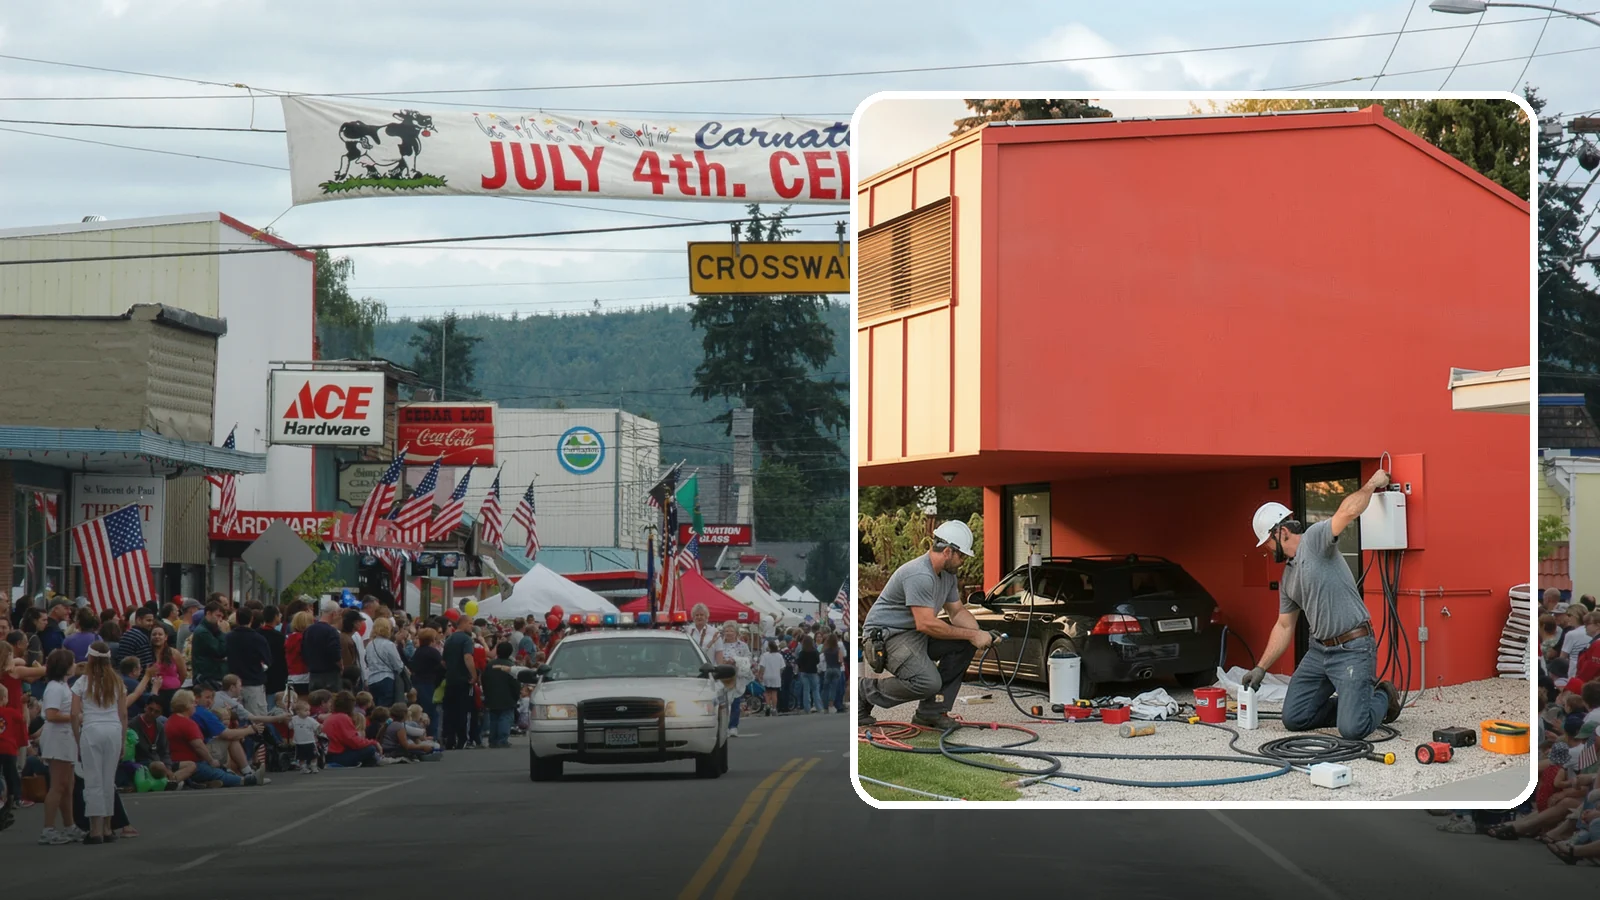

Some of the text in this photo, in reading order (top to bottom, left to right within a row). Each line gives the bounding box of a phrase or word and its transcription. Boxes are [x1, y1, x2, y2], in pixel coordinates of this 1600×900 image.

[481, 141, 605, 193] JULY
[633, 150, 746, 198] 4th.
[697, 254, 850, 280] CROSSWA
[283, 380, 373, 419] ACE
[405, 409, 452, 422] CEDAR
[283, 421, 371, 436] Hardware
[416, 428, 476, 447] Coca-Cola
[83, 485, 155, 495] St. Vincent de Paul
[688, 526, 741, 535] CRNATION
[699, 535, 730, 543] GLASS
